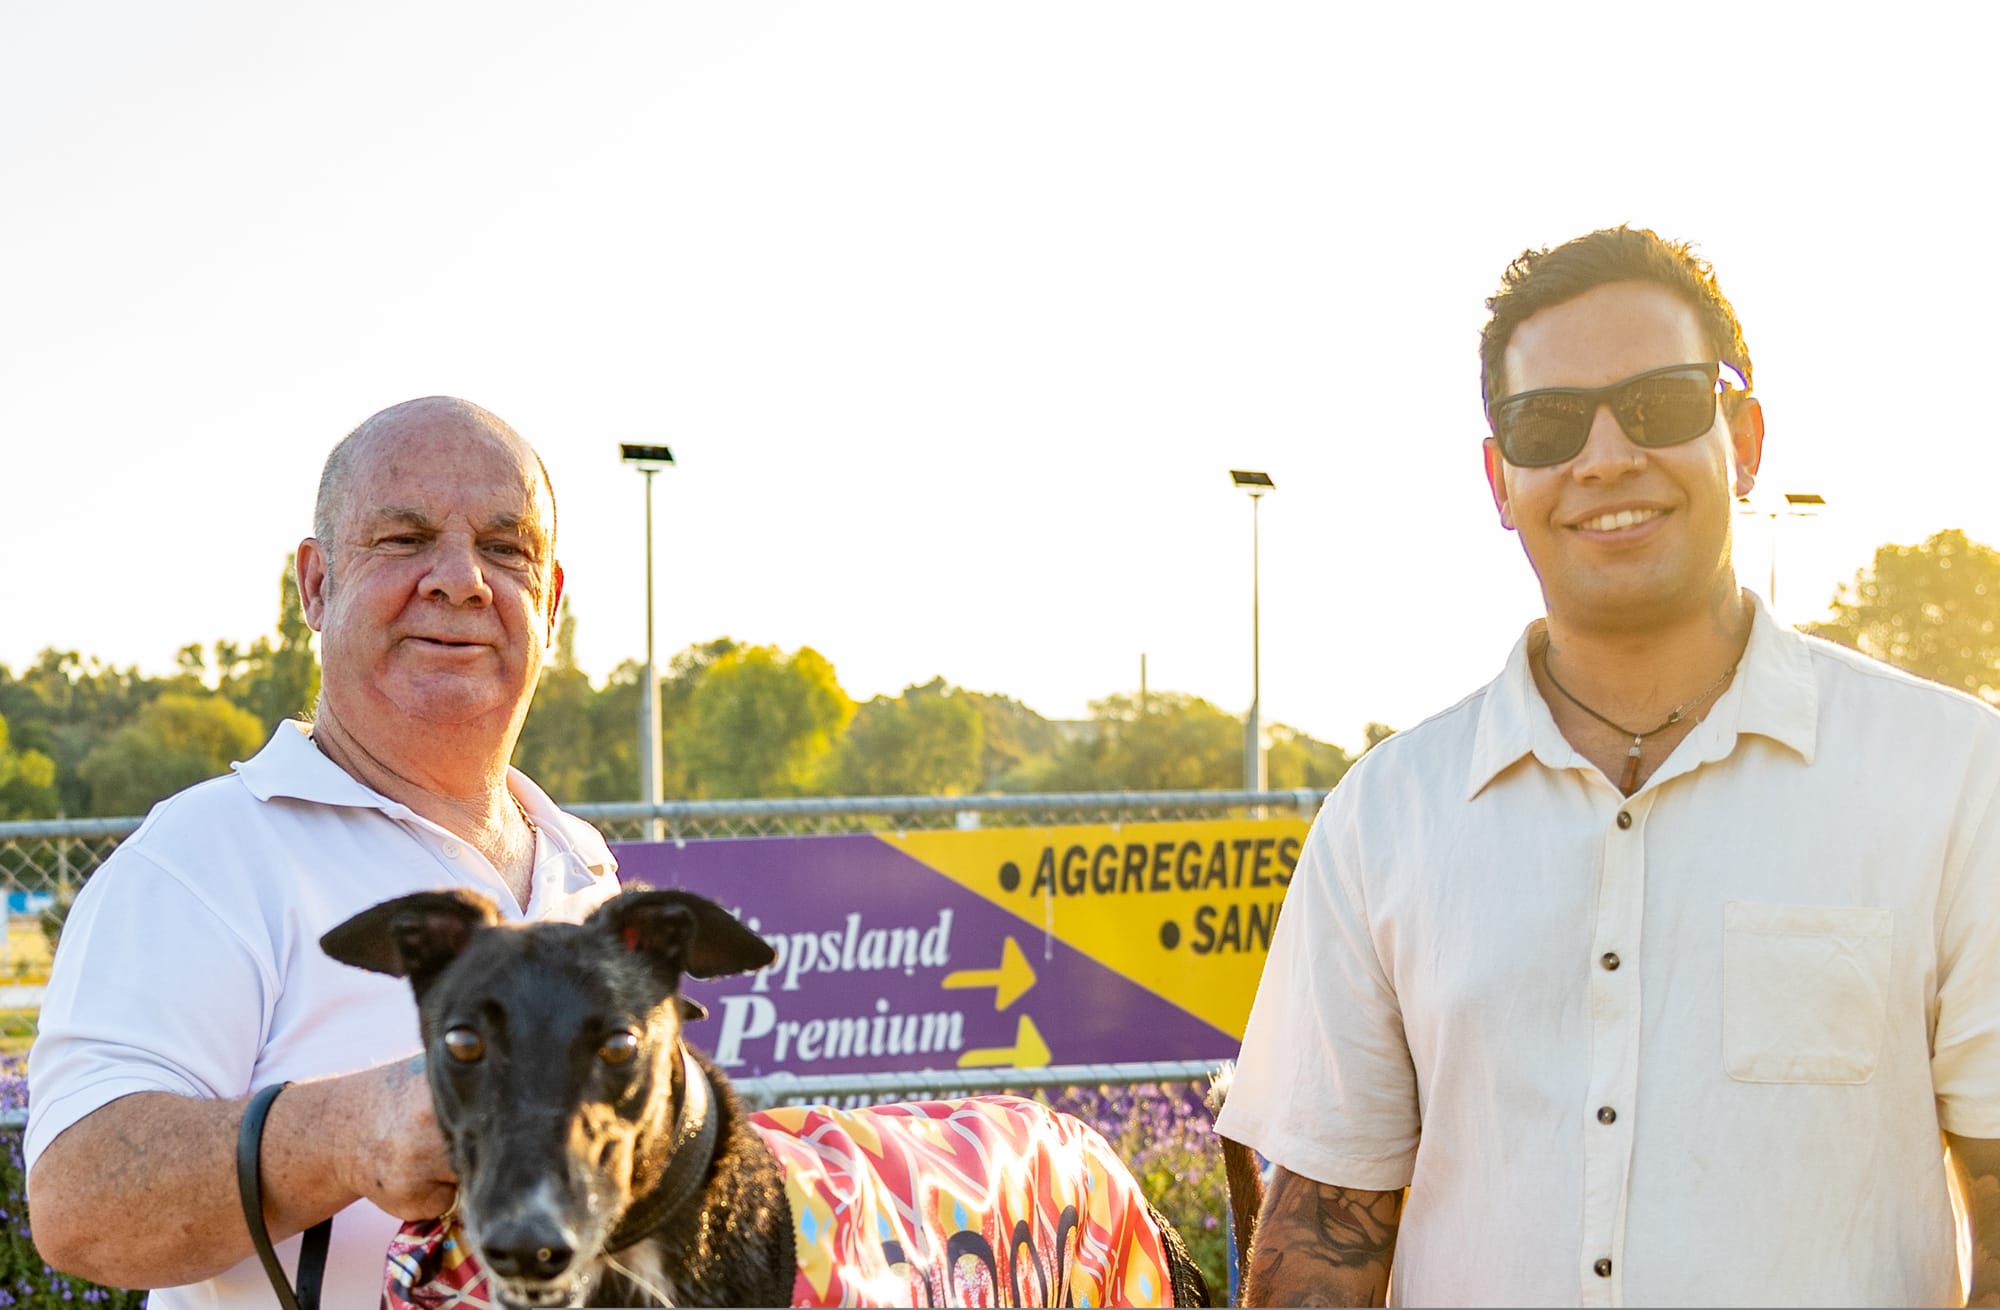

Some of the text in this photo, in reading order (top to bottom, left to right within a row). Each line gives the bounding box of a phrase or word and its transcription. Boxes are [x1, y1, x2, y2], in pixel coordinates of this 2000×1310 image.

[1030, 838, 1299, 897] AGGREGATES
[734, 907, 953, 992] ppsland
[1190, 902, 1281, 955] SAN
[713, 994, 964, 1067] Premium
